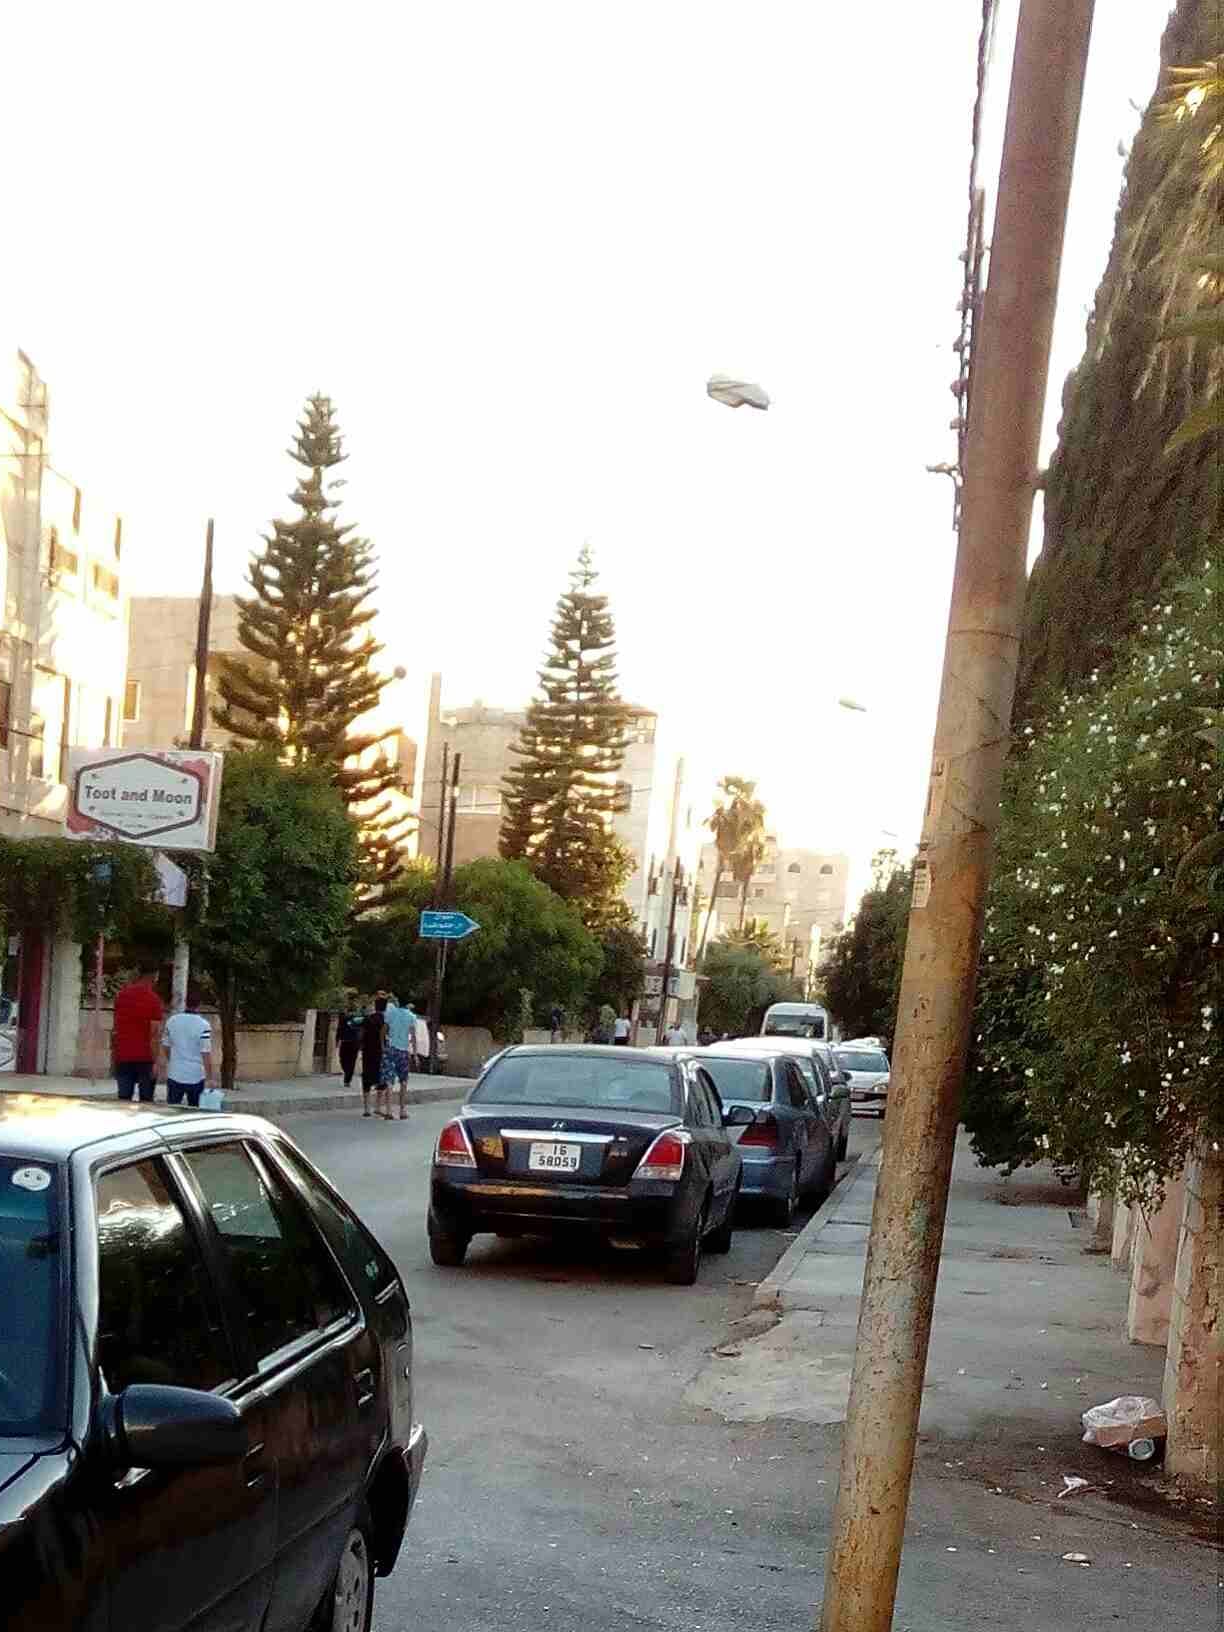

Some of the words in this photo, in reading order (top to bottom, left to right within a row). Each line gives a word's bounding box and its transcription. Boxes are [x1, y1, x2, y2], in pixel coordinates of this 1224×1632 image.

[85, 784, 116, 801] Toot
[120, 789, 148, 802] and
[152, 789, 192, 805] Moon
